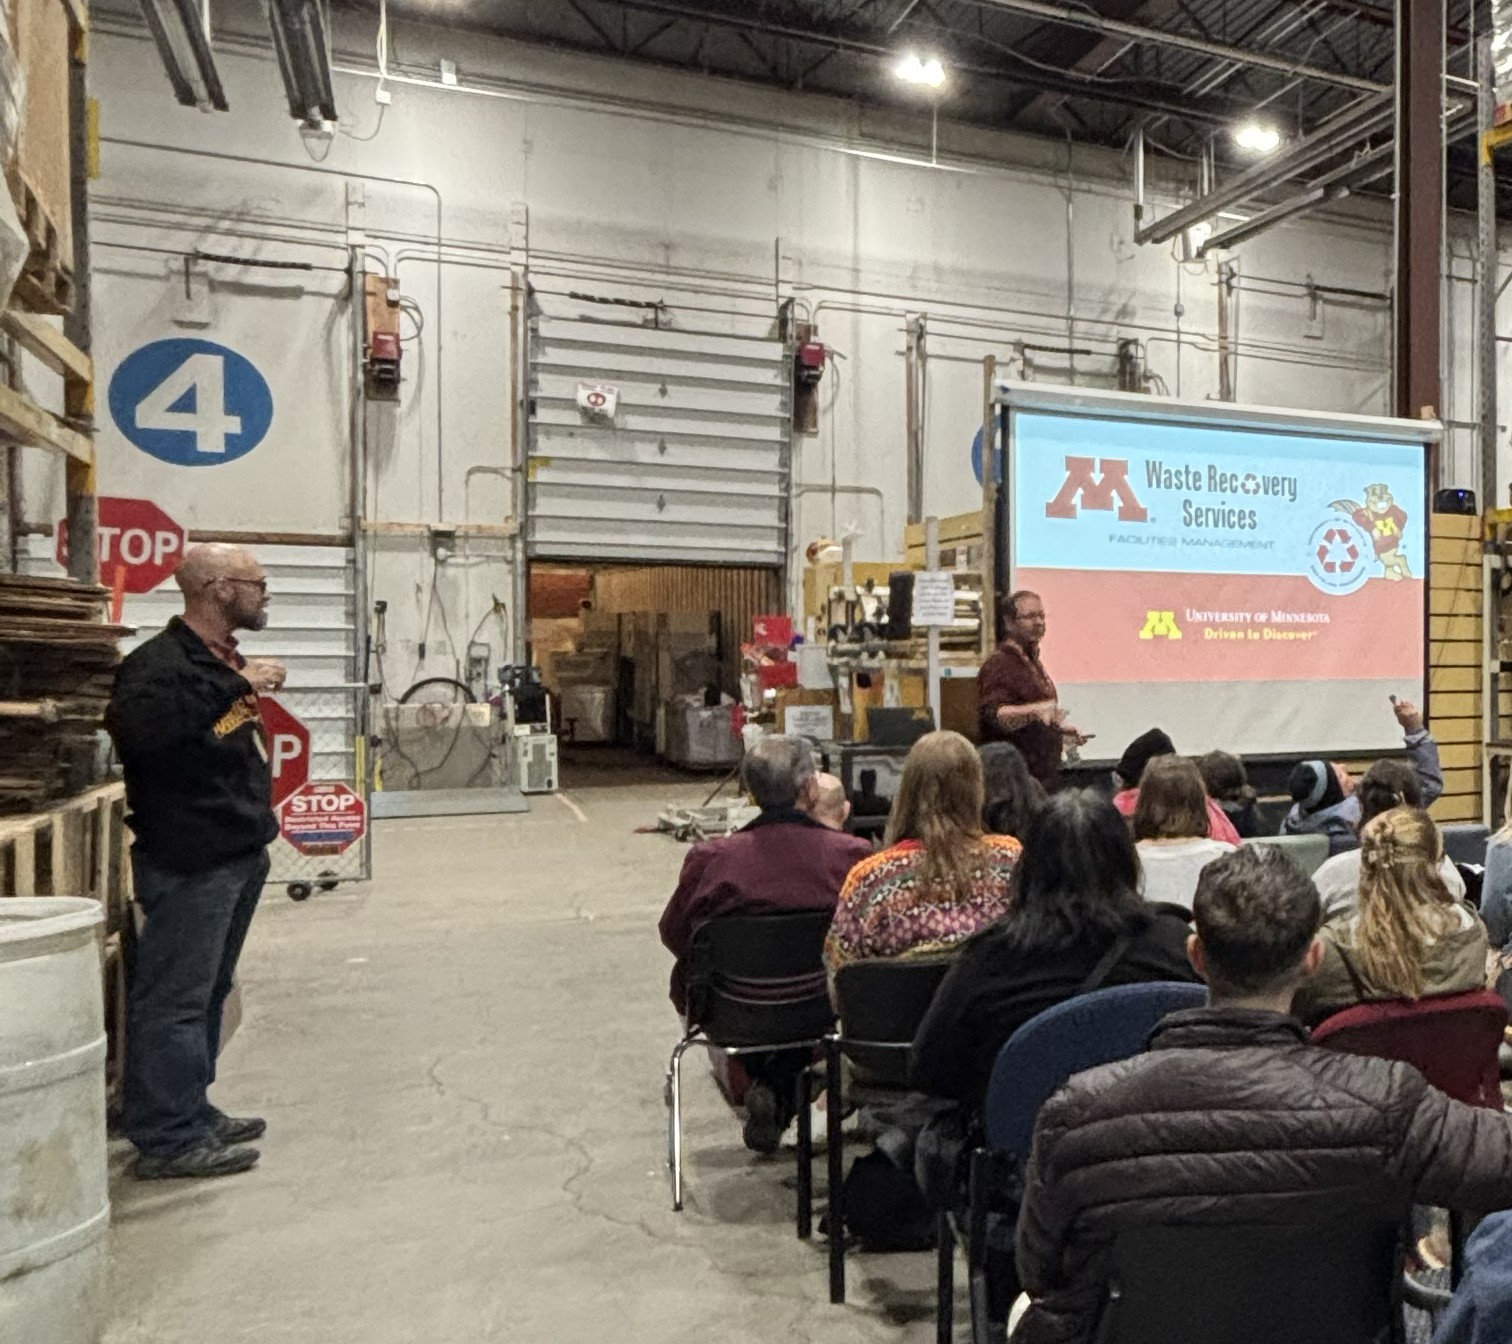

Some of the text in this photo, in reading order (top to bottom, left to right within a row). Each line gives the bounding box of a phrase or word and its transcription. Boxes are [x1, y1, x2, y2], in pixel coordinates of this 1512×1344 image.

[135, 354, 241, 453] 4
[1045, 456, 1148, 523] M
[1145, 460, 1201, 491] Waste
[1182, 499, 1257, 530] Services
[97, 526, 179, 566] TOP
[1109, 534, 1275, 549] FACILITIES MANAGEMENT
[1139, 611, 1183, 640] M
[1186, 609, 1250, 623] UNIVERSITY
[1271, 610, 1330, 623] MINNESOTA
[1204, 627, 1244, 640] Driven
[1248, 628, 1260, 640] to
[291, 795, 356, 813] STOP
